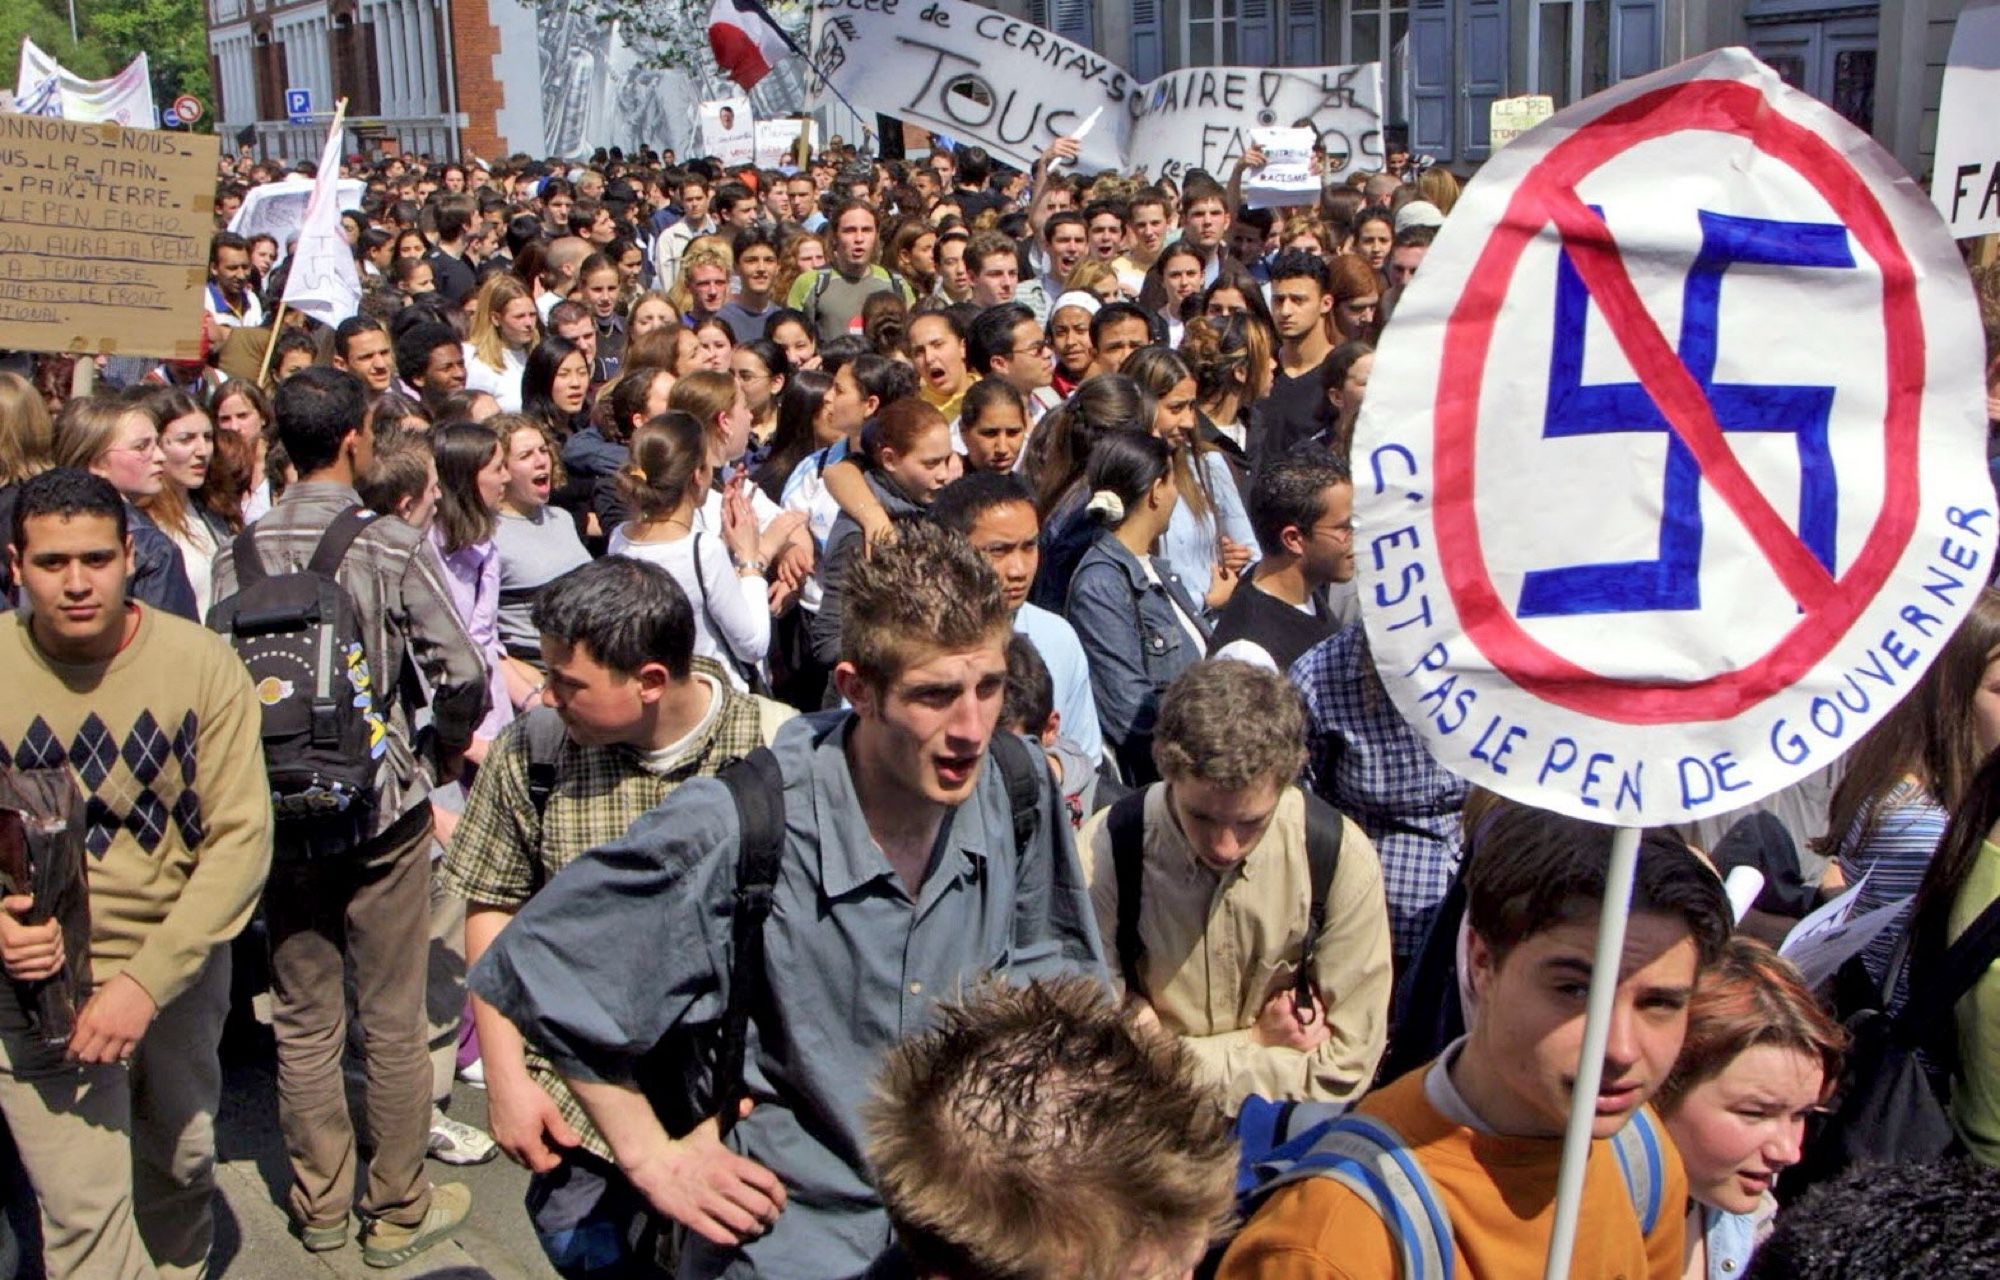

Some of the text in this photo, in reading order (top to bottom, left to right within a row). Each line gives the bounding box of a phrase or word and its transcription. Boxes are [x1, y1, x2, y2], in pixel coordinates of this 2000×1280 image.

[919, 3, 951, 29] de
[292, 93, 305, 112] P
[896, 35, 1079, 168] TOUS
[1199, 123, 1384, 177] FAOS
[93, 183, 172, 209] TERRE
[1369, 443, 1992, 813] C'EST PAS LE PEN DE GOUVERNER
